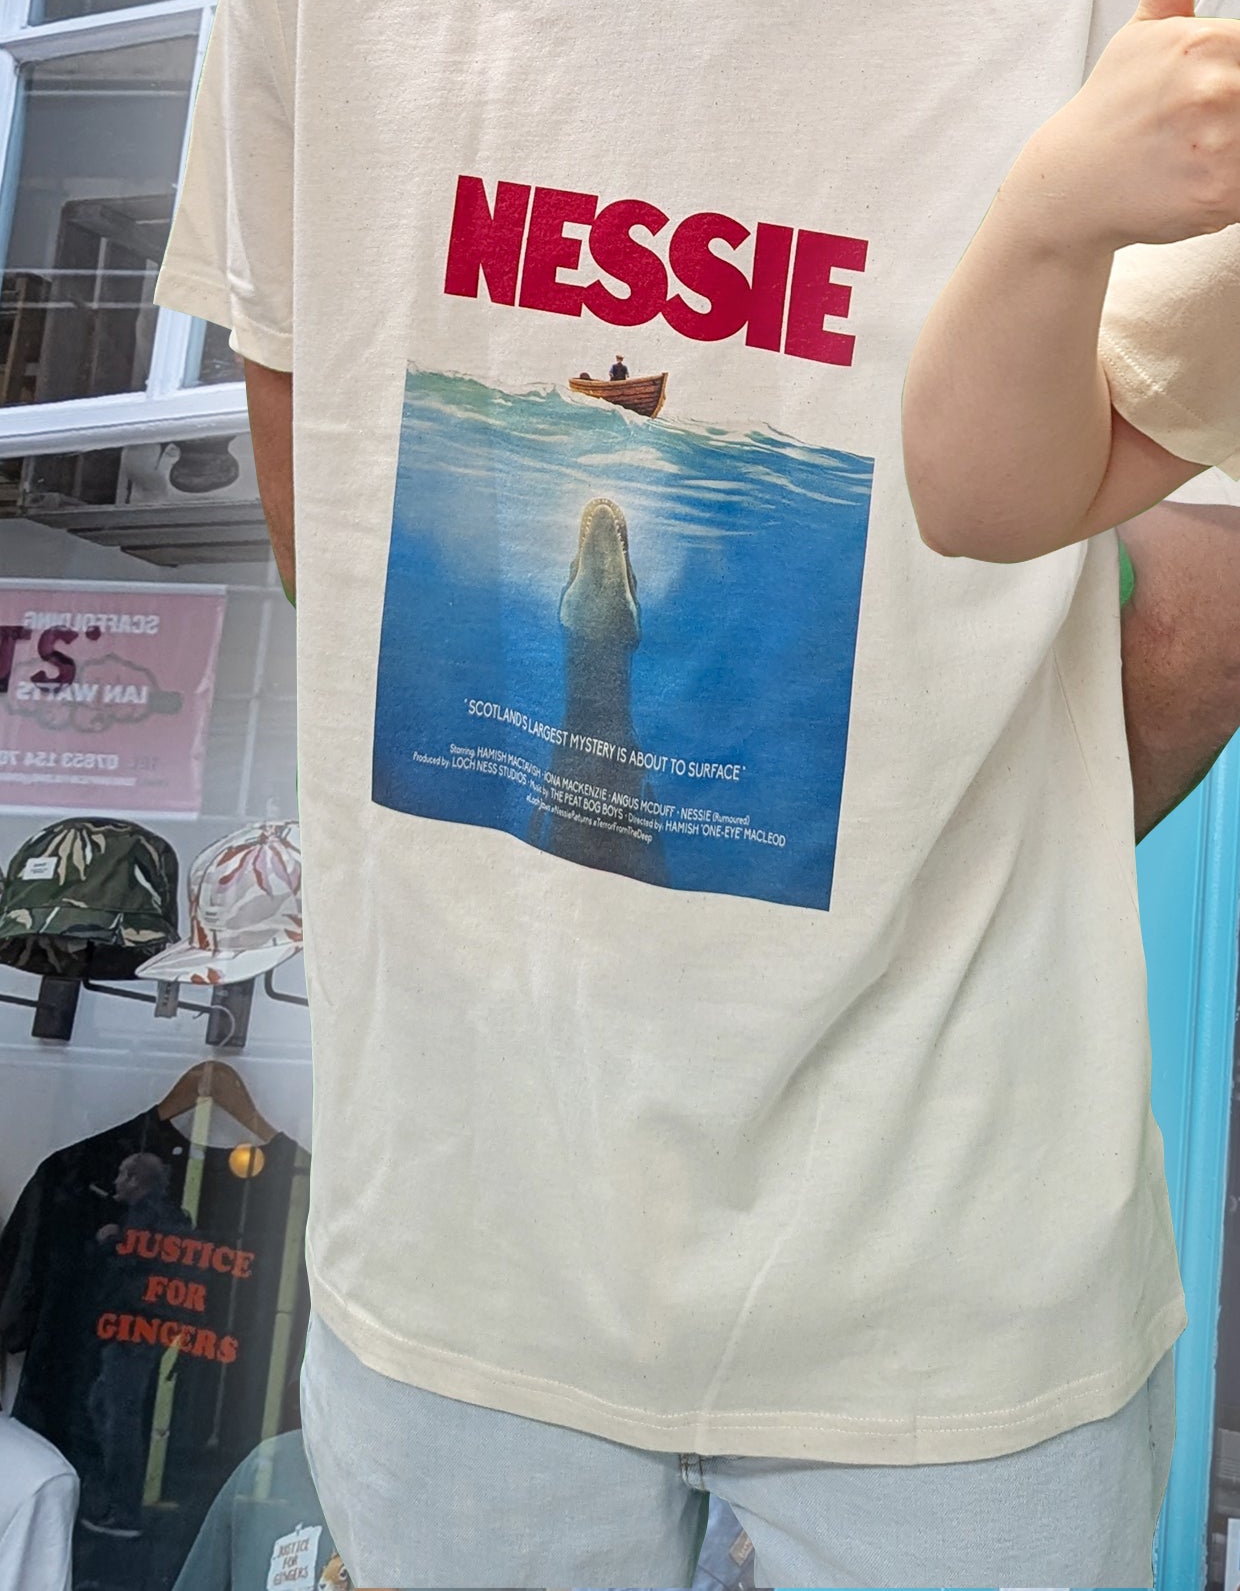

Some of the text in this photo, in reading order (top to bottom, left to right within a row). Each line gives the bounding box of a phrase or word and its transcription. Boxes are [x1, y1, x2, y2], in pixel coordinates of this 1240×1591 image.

[443, 174, 868, 366] NESSIE
[528, 719, 568, 747] LARGEST
[569, 733, 616, 759] MYSTERY
[617, 746, 627, 763] IS
[629, 750, 668, 772] ABOUT
[671, 758, 686, 776] TO
[452, 756, 476, 771] LOCH
[477, 761, 498, 775] NESS
[498, 766, 527, 785] STUDIOS
[550, 788, 564, 803] THE
[564, 792, 583, 807] PEAT
[583, 798, 601, 813] BOG
[602, 803, 623, 820] BOYS
[665, 820, 699, 836] HAMISH
[743, 828, 786, 847] MACLEOD
[476, 746, 507, 763] HAMISH
[561, 777, 607, 800] MACKENZIE
[611, 792, 639, 810] ANGUS
[640, 800, 676, 818] MCDUFF
[681, 808, 711, 822] NESSIE
[115, 1228, 255, 1278] JUSTICE
[142, 1275, 206, 1312] FOR
[96, 1313, 239, 1364] GINGERS
